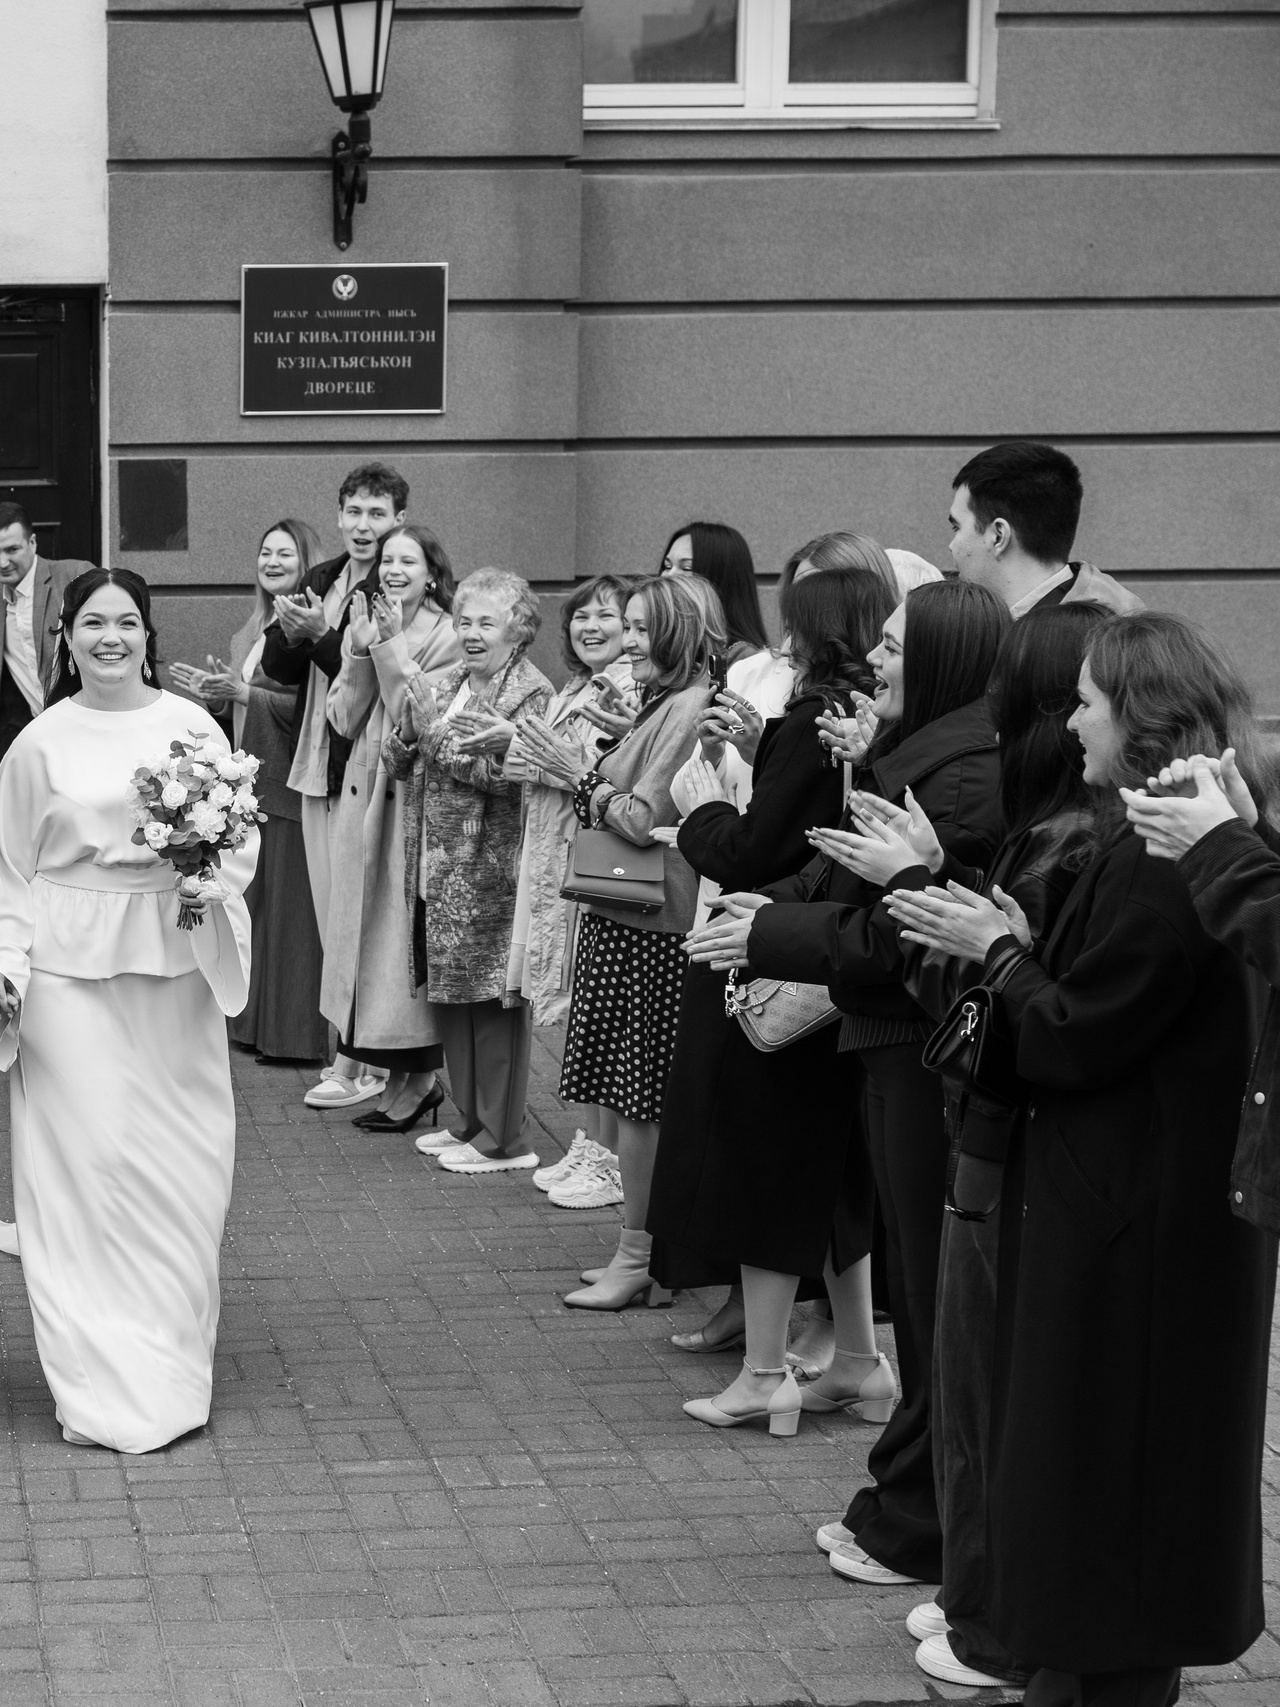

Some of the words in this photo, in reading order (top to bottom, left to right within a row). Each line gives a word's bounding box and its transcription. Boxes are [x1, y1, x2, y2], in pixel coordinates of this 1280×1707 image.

[253, 331, 295, 344] КИАГ
[298, 330, 436, 344] КИВАЛТОННИЛЭН
[277, 355, 412, 369] КУЗПАЛЪЯСЬКОН
[303, 381, 376, 396] ДВОРЕЦЕ
